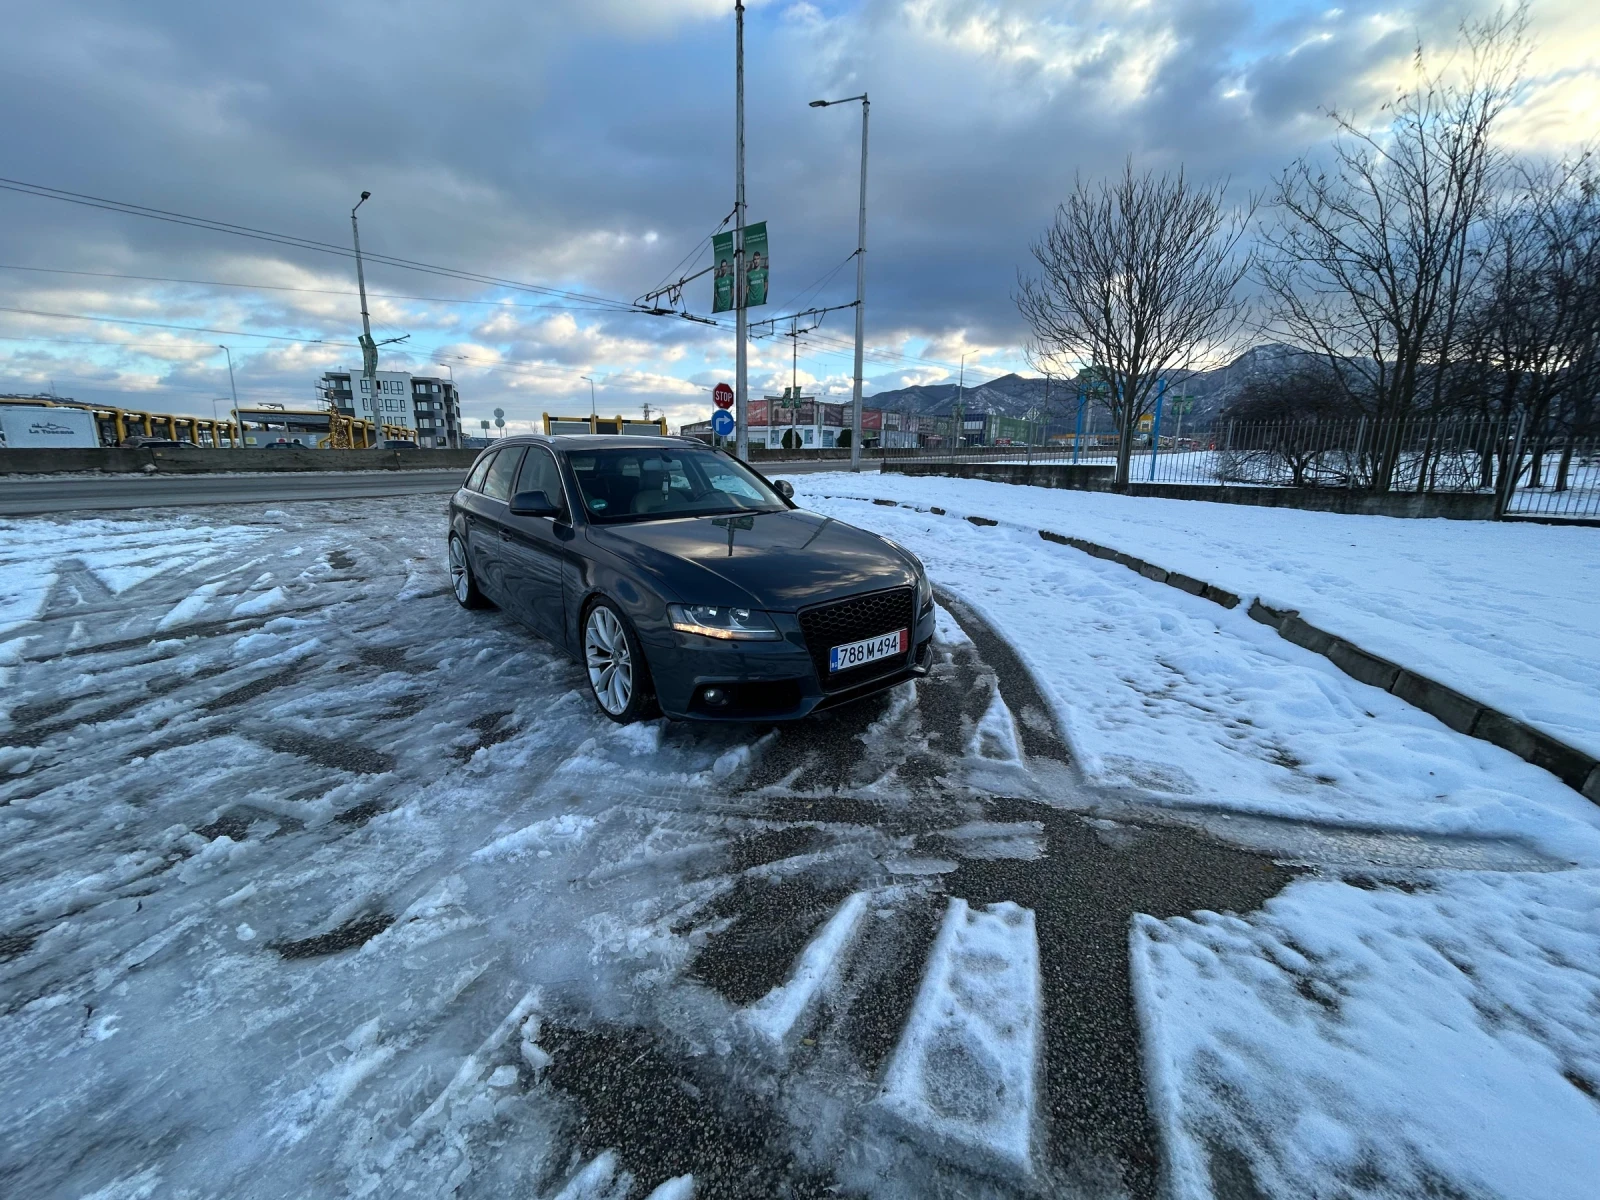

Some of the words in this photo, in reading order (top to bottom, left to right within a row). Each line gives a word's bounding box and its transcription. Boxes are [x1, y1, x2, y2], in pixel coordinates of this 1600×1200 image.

[715, 390, 733, 402] STOP
[840, 645, 864, 666] 788
[867, 642, 875, 659] M
[877, 635, 897, 655] 494
